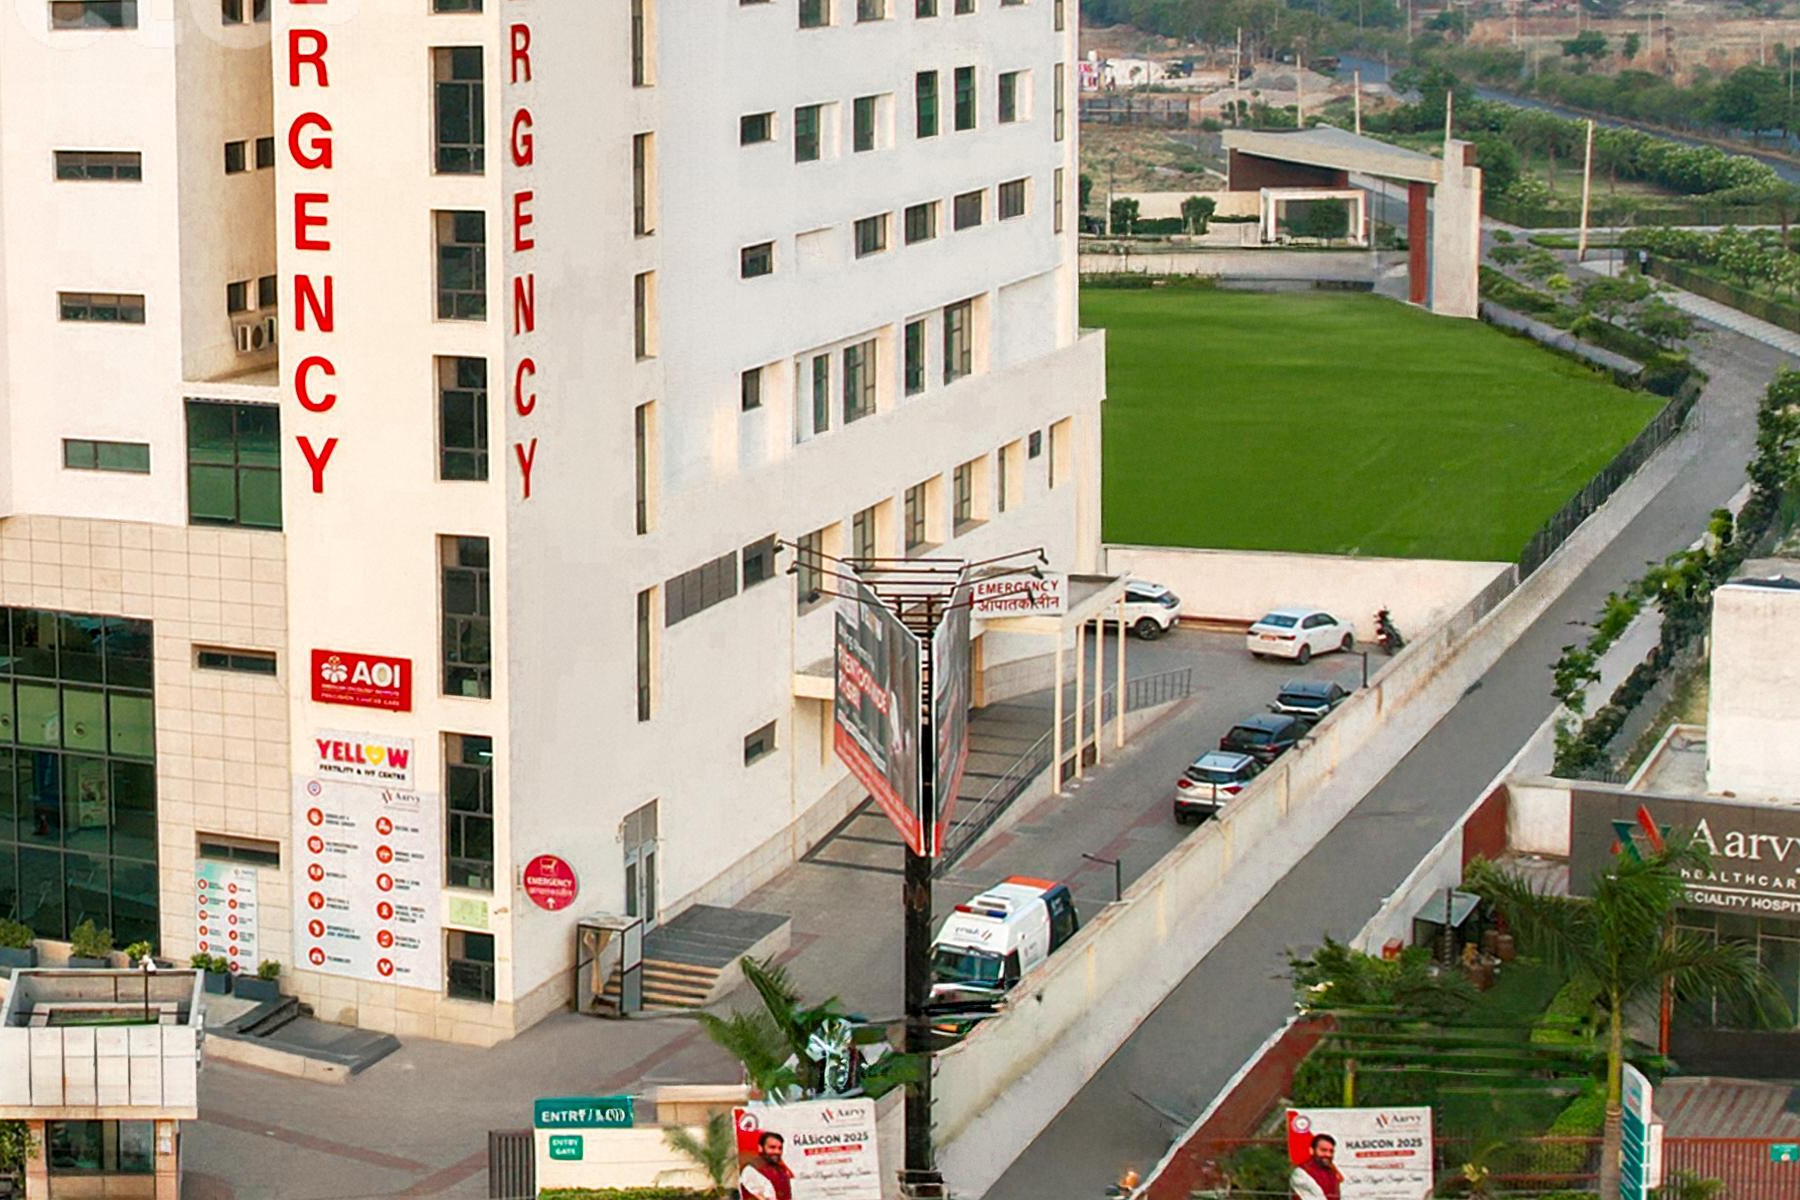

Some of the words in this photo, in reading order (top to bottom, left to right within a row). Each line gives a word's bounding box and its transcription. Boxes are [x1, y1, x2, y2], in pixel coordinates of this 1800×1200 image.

[977, 579, 1059, 595] EMERGENCY
[351, 660, 401, 689] AOI
[319, 763, 354, 774] FERTILITY
[378, 770, 406, 781] CENTRE
[1345, 1139, 1394, 1150] HASICON
[1396, 1137, 1423, 1149] 2025
